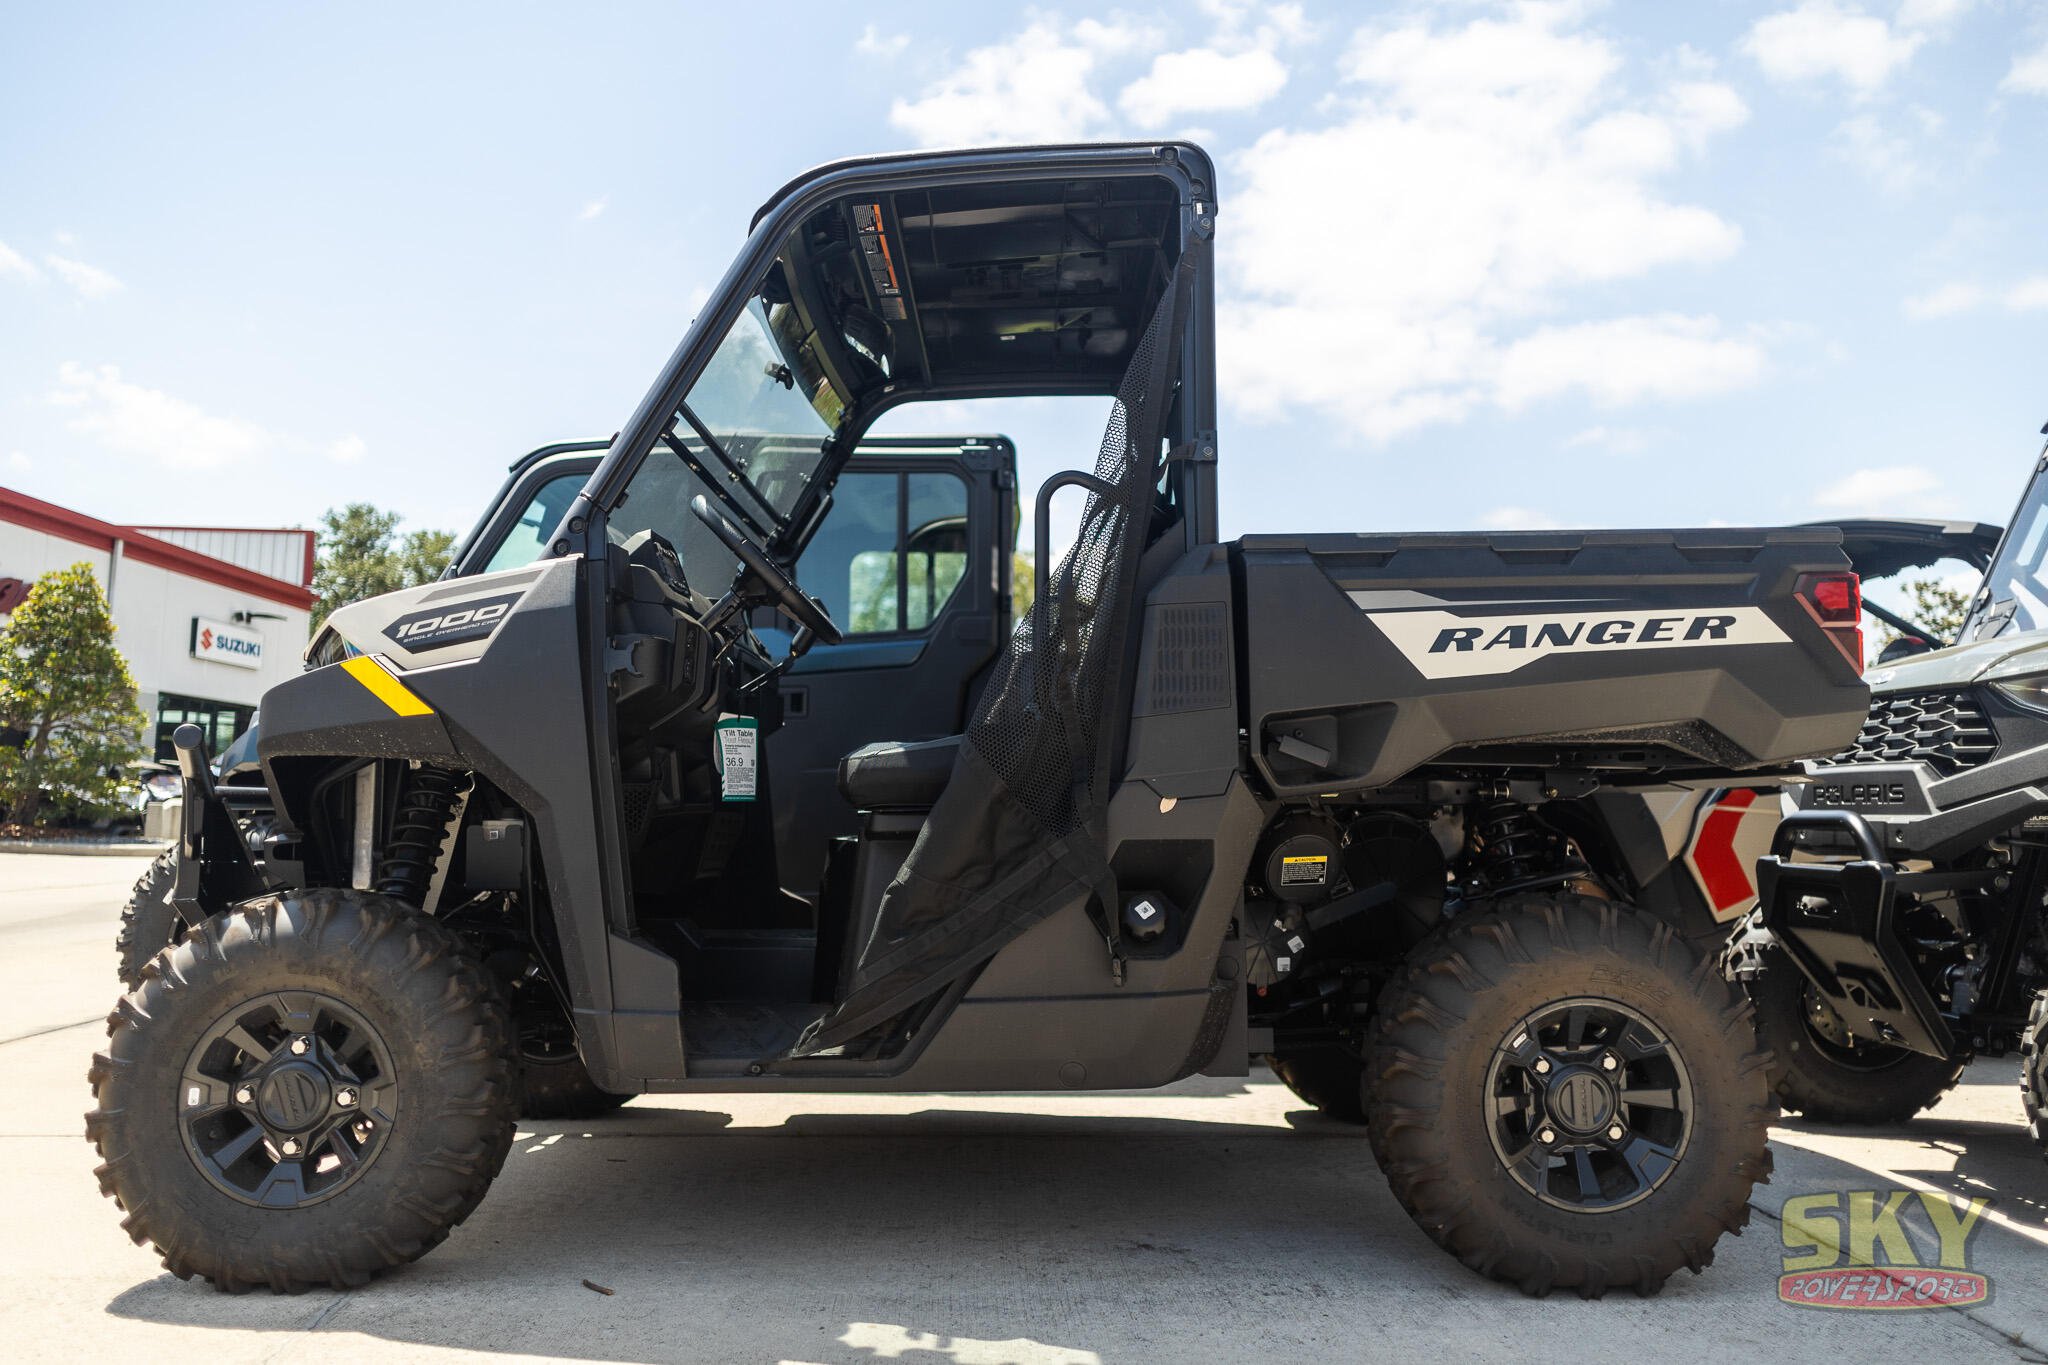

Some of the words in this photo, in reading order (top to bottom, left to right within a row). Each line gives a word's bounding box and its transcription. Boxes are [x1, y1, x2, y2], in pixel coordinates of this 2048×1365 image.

[396, 603, 509, 639] 1000
[403, 632, 433, 643] SINGLE
[435, 623, 481, 636] OVERHEAD
[481, 618, 501, 626] CAM
[1428, 615, 1737, 653] RANGER
[216, 635, 261, 657] SUZUKI
[737, 729, 754, 738] Table
[725, 757, 744, 767] 36.9
[1813, 784, 1906, 806] POLARIS
